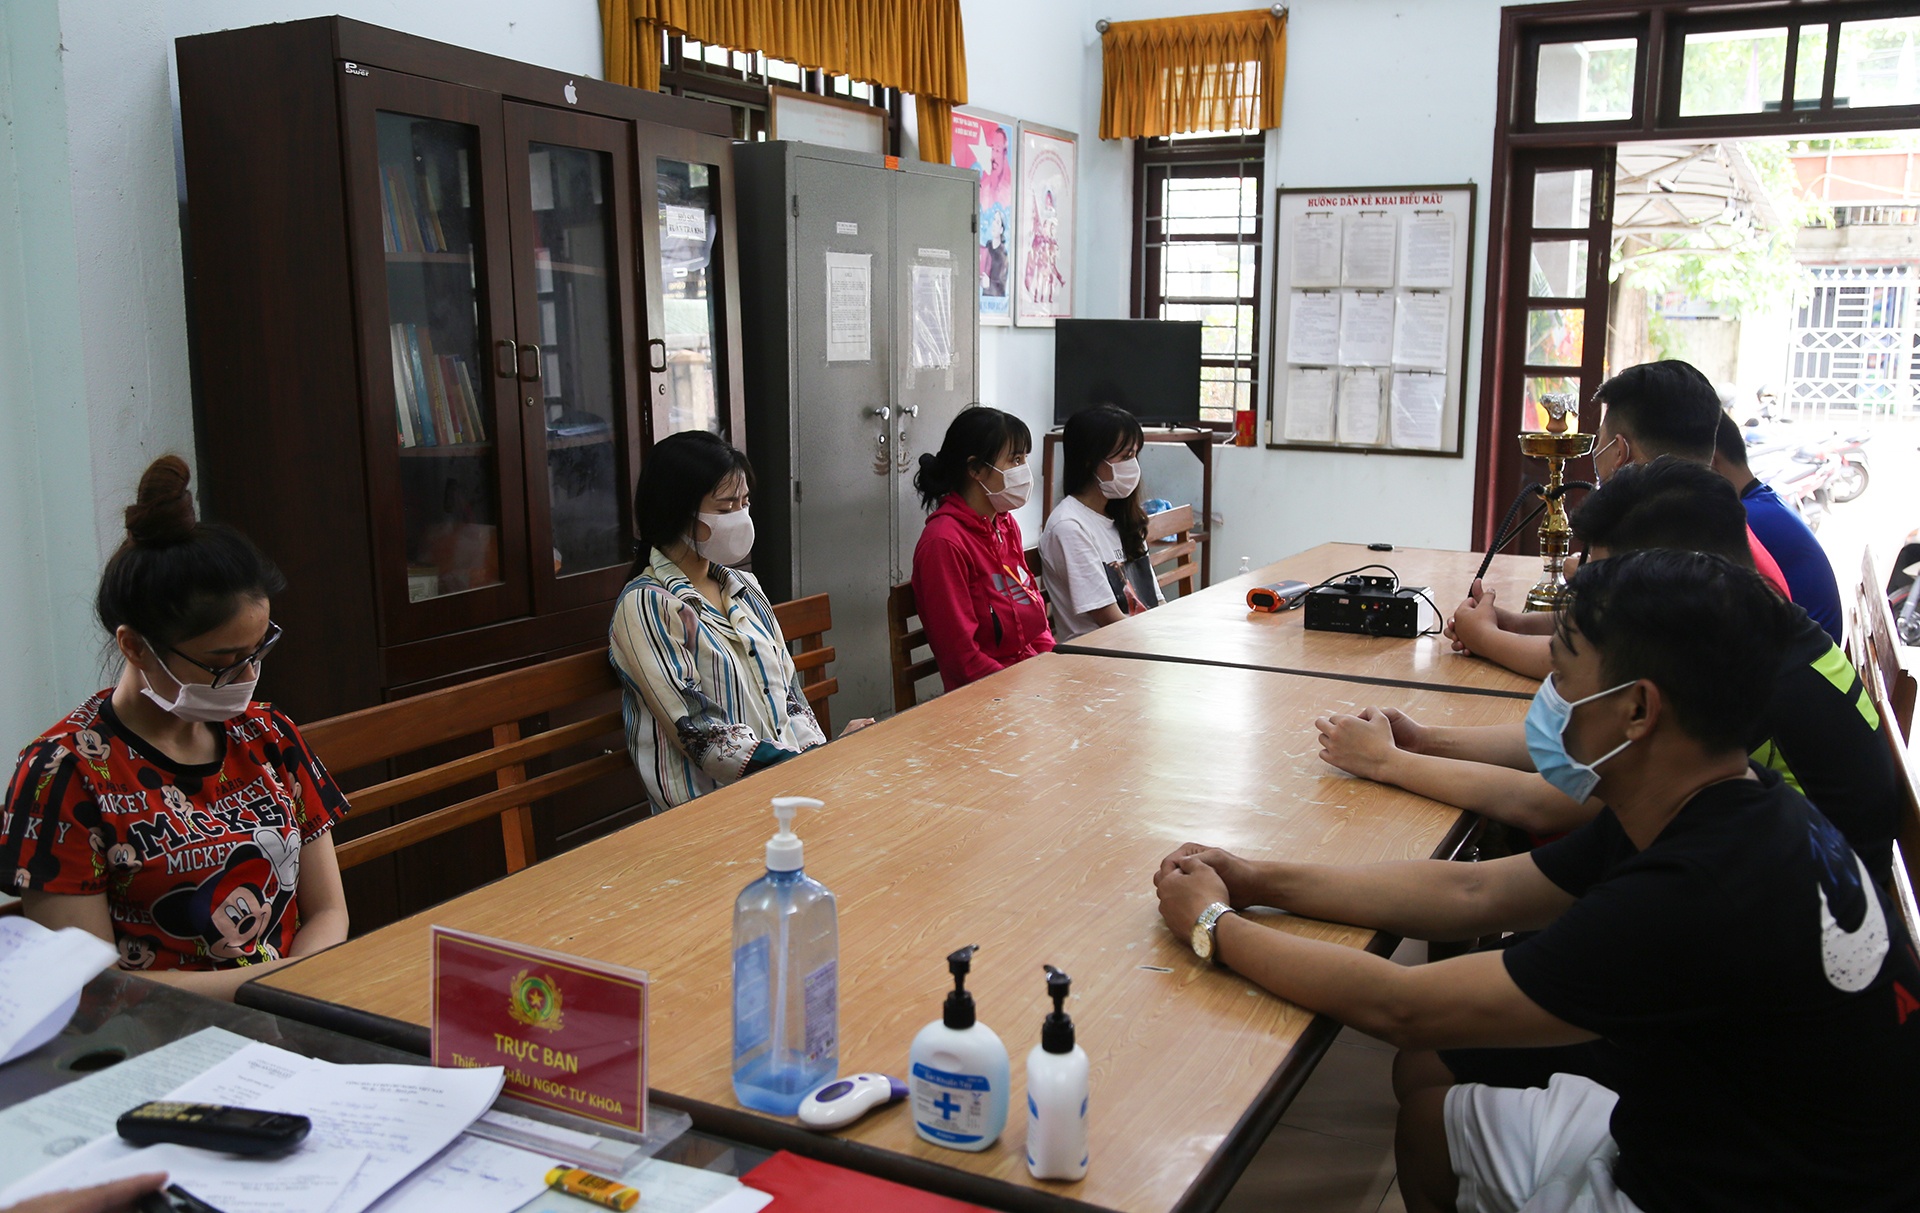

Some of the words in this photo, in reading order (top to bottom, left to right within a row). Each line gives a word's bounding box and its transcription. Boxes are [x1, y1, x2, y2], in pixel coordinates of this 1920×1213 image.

[1308, 194, 1338, 207] HƯỚNG
[1375, 196, 1397, 206] KHAI
[206, 775, 271, 815] MICKEY
[215, 777, 245, 797] PARIS
[130, 793, 299, 861] MICKEY
[494, 1033, 539, 1062] TRỰC
[543, 1048, 578, 1074] BAN
[505, 1069, 531, 1088] HÂU
[533, 1077, 566, 1098] NGỌC
[569, 1087, 587, 1104] TƯ
[589, 1093, 623, 1115] KHOA
